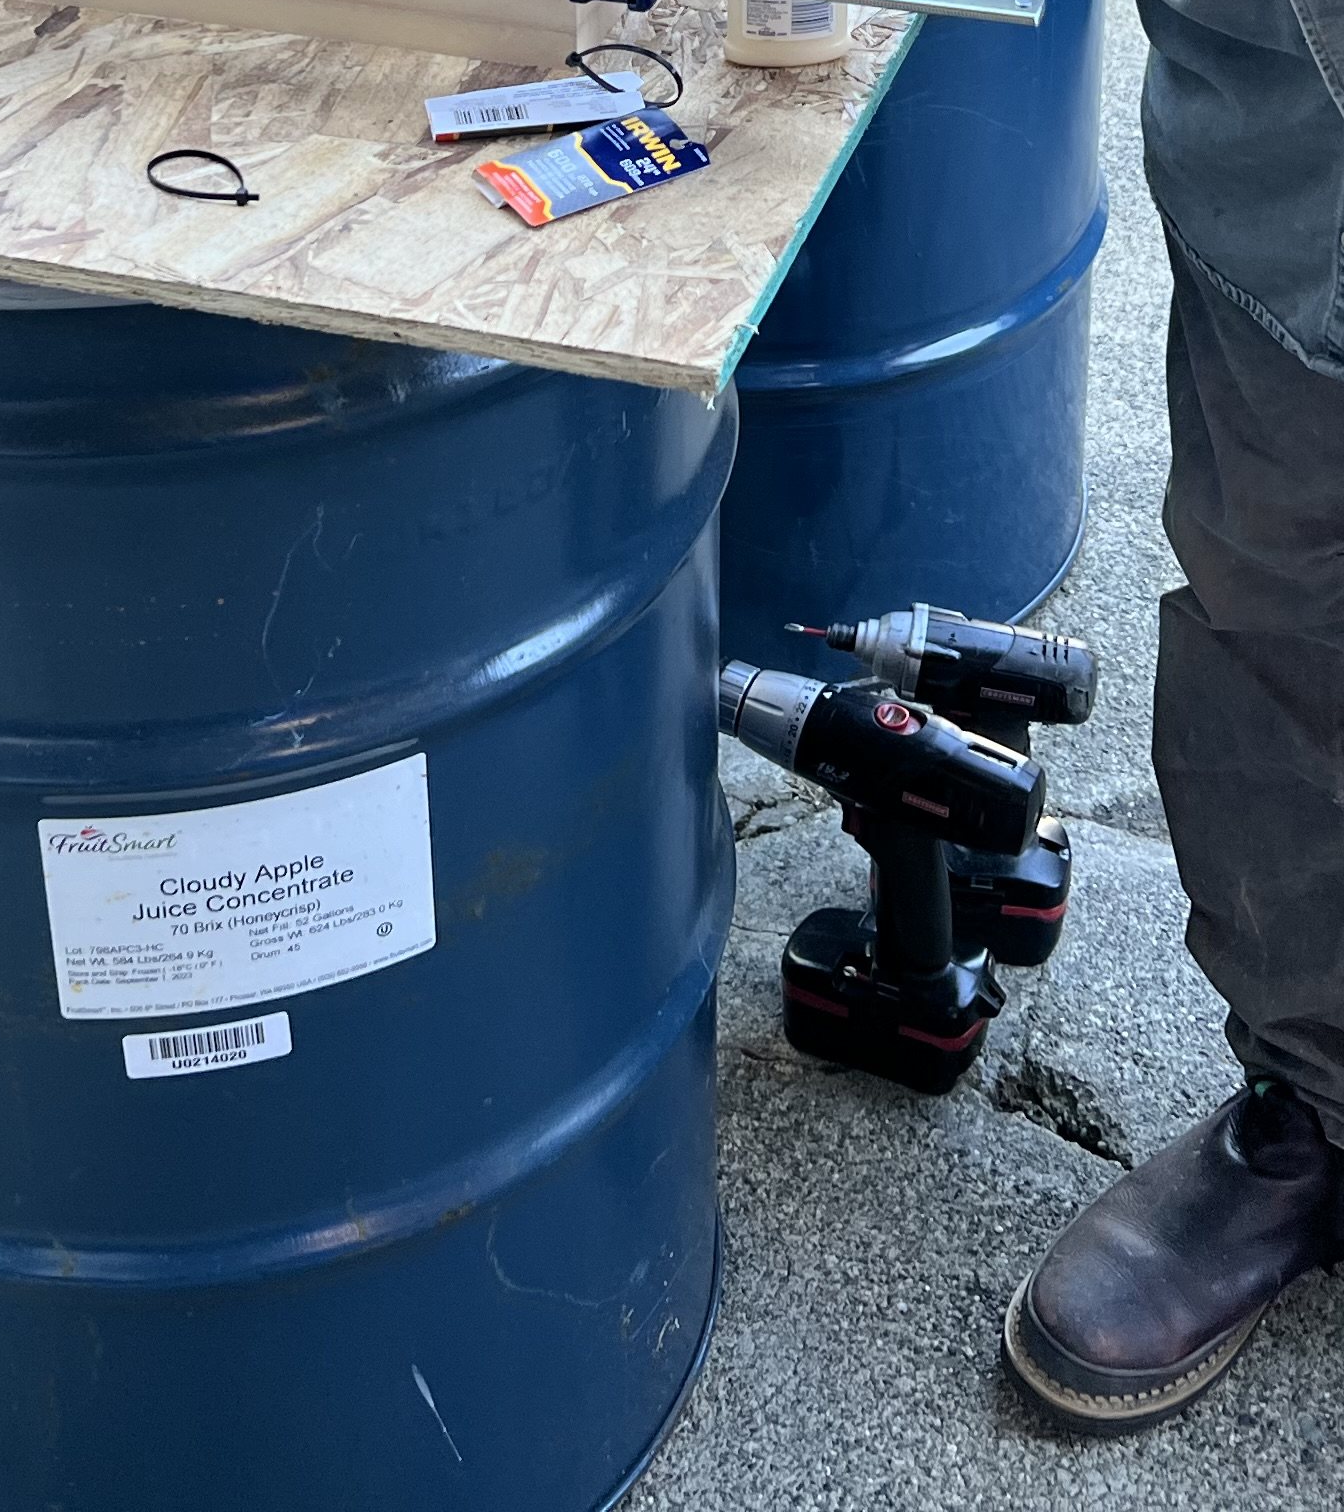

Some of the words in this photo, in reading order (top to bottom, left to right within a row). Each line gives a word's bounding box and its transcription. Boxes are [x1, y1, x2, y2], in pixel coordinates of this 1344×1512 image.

[621, 116, 681, 174] IRWIN
[548, 148, 578, 174] 600
[788, 725, 798, 738] 20
[50, 832, 177, 854] FruitSmart
[160, 871, 246, 896] Cloudy
[254, 854, 324, 884] Apple
[133, 901, 197, 921] Juice
[206, 869, 354, 913] Concentrate
[171, 924, 189, 936] 70
[194, 920, 223, 935] Brix
[228, 899, 321, 930] (Honeycrisp)
[249, 926, 269, 937] Net
[312, 905, 354, 922] Gallons
[250, 936, 284, 948] Gross
[389, 899, 403, 911] Kg
[66, 957, 85, 966] Net
[197, 949, 214, 959] Kg
[251, 949, 281, 961] Drum
[172, 1049, 247, 1070] U0214020
